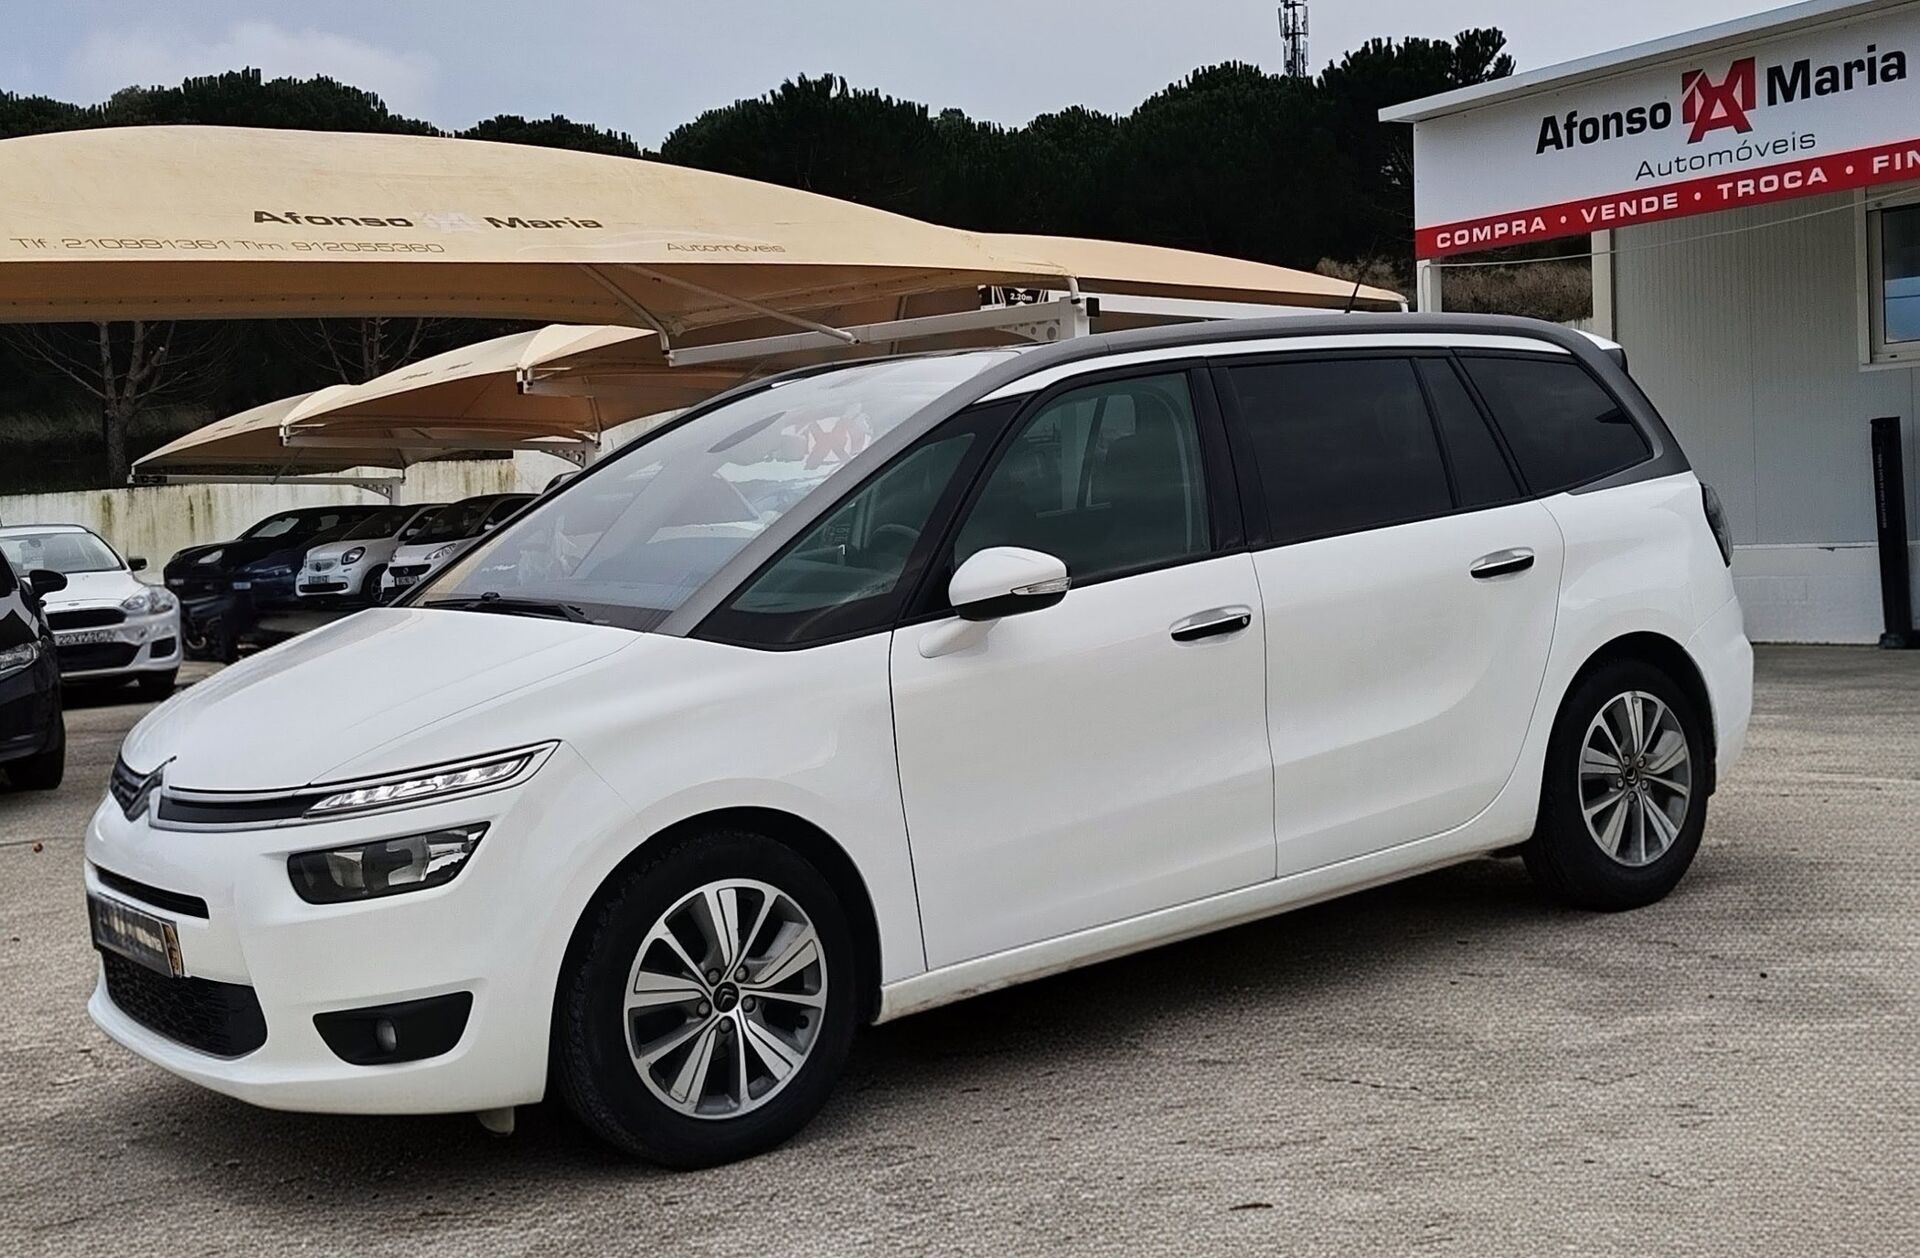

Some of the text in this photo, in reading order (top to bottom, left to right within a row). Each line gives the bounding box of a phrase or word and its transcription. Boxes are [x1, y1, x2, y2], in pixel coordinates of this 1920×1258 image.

[1535, 101, 1672, 155] Afonso
[1766, 44, 1908, 107] Maria
[1635, 131, 1817, 182] Automóveis
[253, 210, 414, 228] Afonso
[484, 216, 603, 229] Maria
[1435, 215, 1547, 249] COMPRA
[1580, 192, 1679, 225] VENDE
[1717, 166, 1829, 200] TROCA
